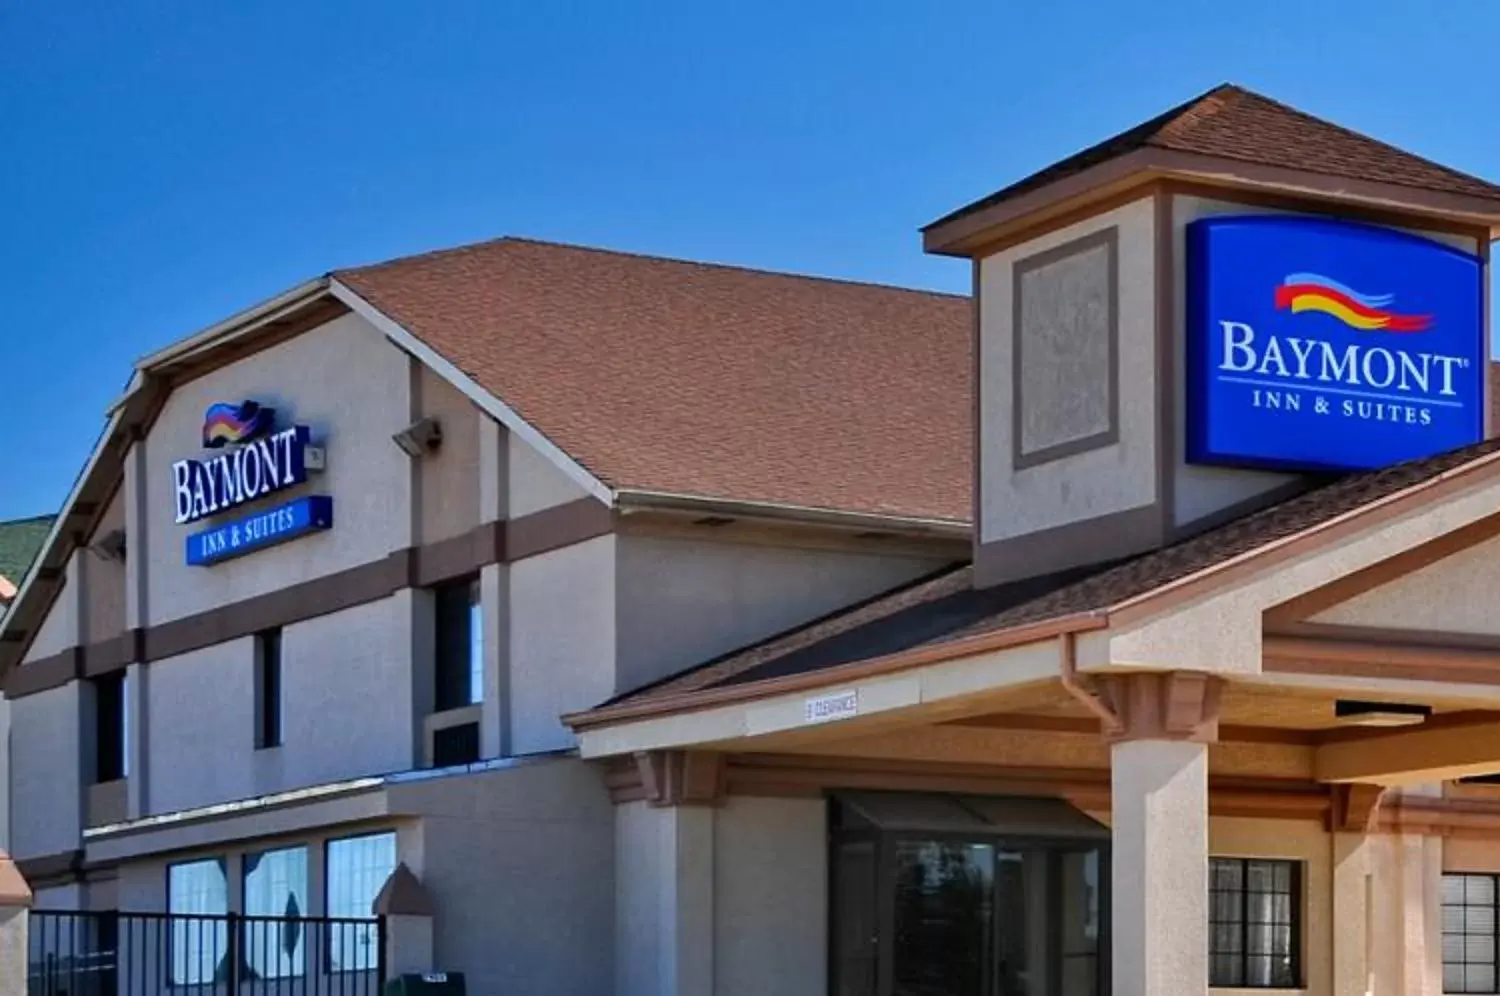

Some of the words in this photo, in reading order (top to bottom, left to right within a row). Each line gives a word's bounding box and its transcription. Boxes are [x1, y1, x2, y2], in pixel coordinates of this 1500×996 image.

[1218, 319, 1463, 396] BAYMONT
[1253, 389, 1300, 412] INN
[1314, 396, 1331, 415] &
[1343, 399, 1432, 426] SUITES
[173, 427, 296, 523] BAYMONT
[202, 530, 226, 556] INN
[231, 525, 240, 548] &
[245, 506, 293, 542] SUITES
